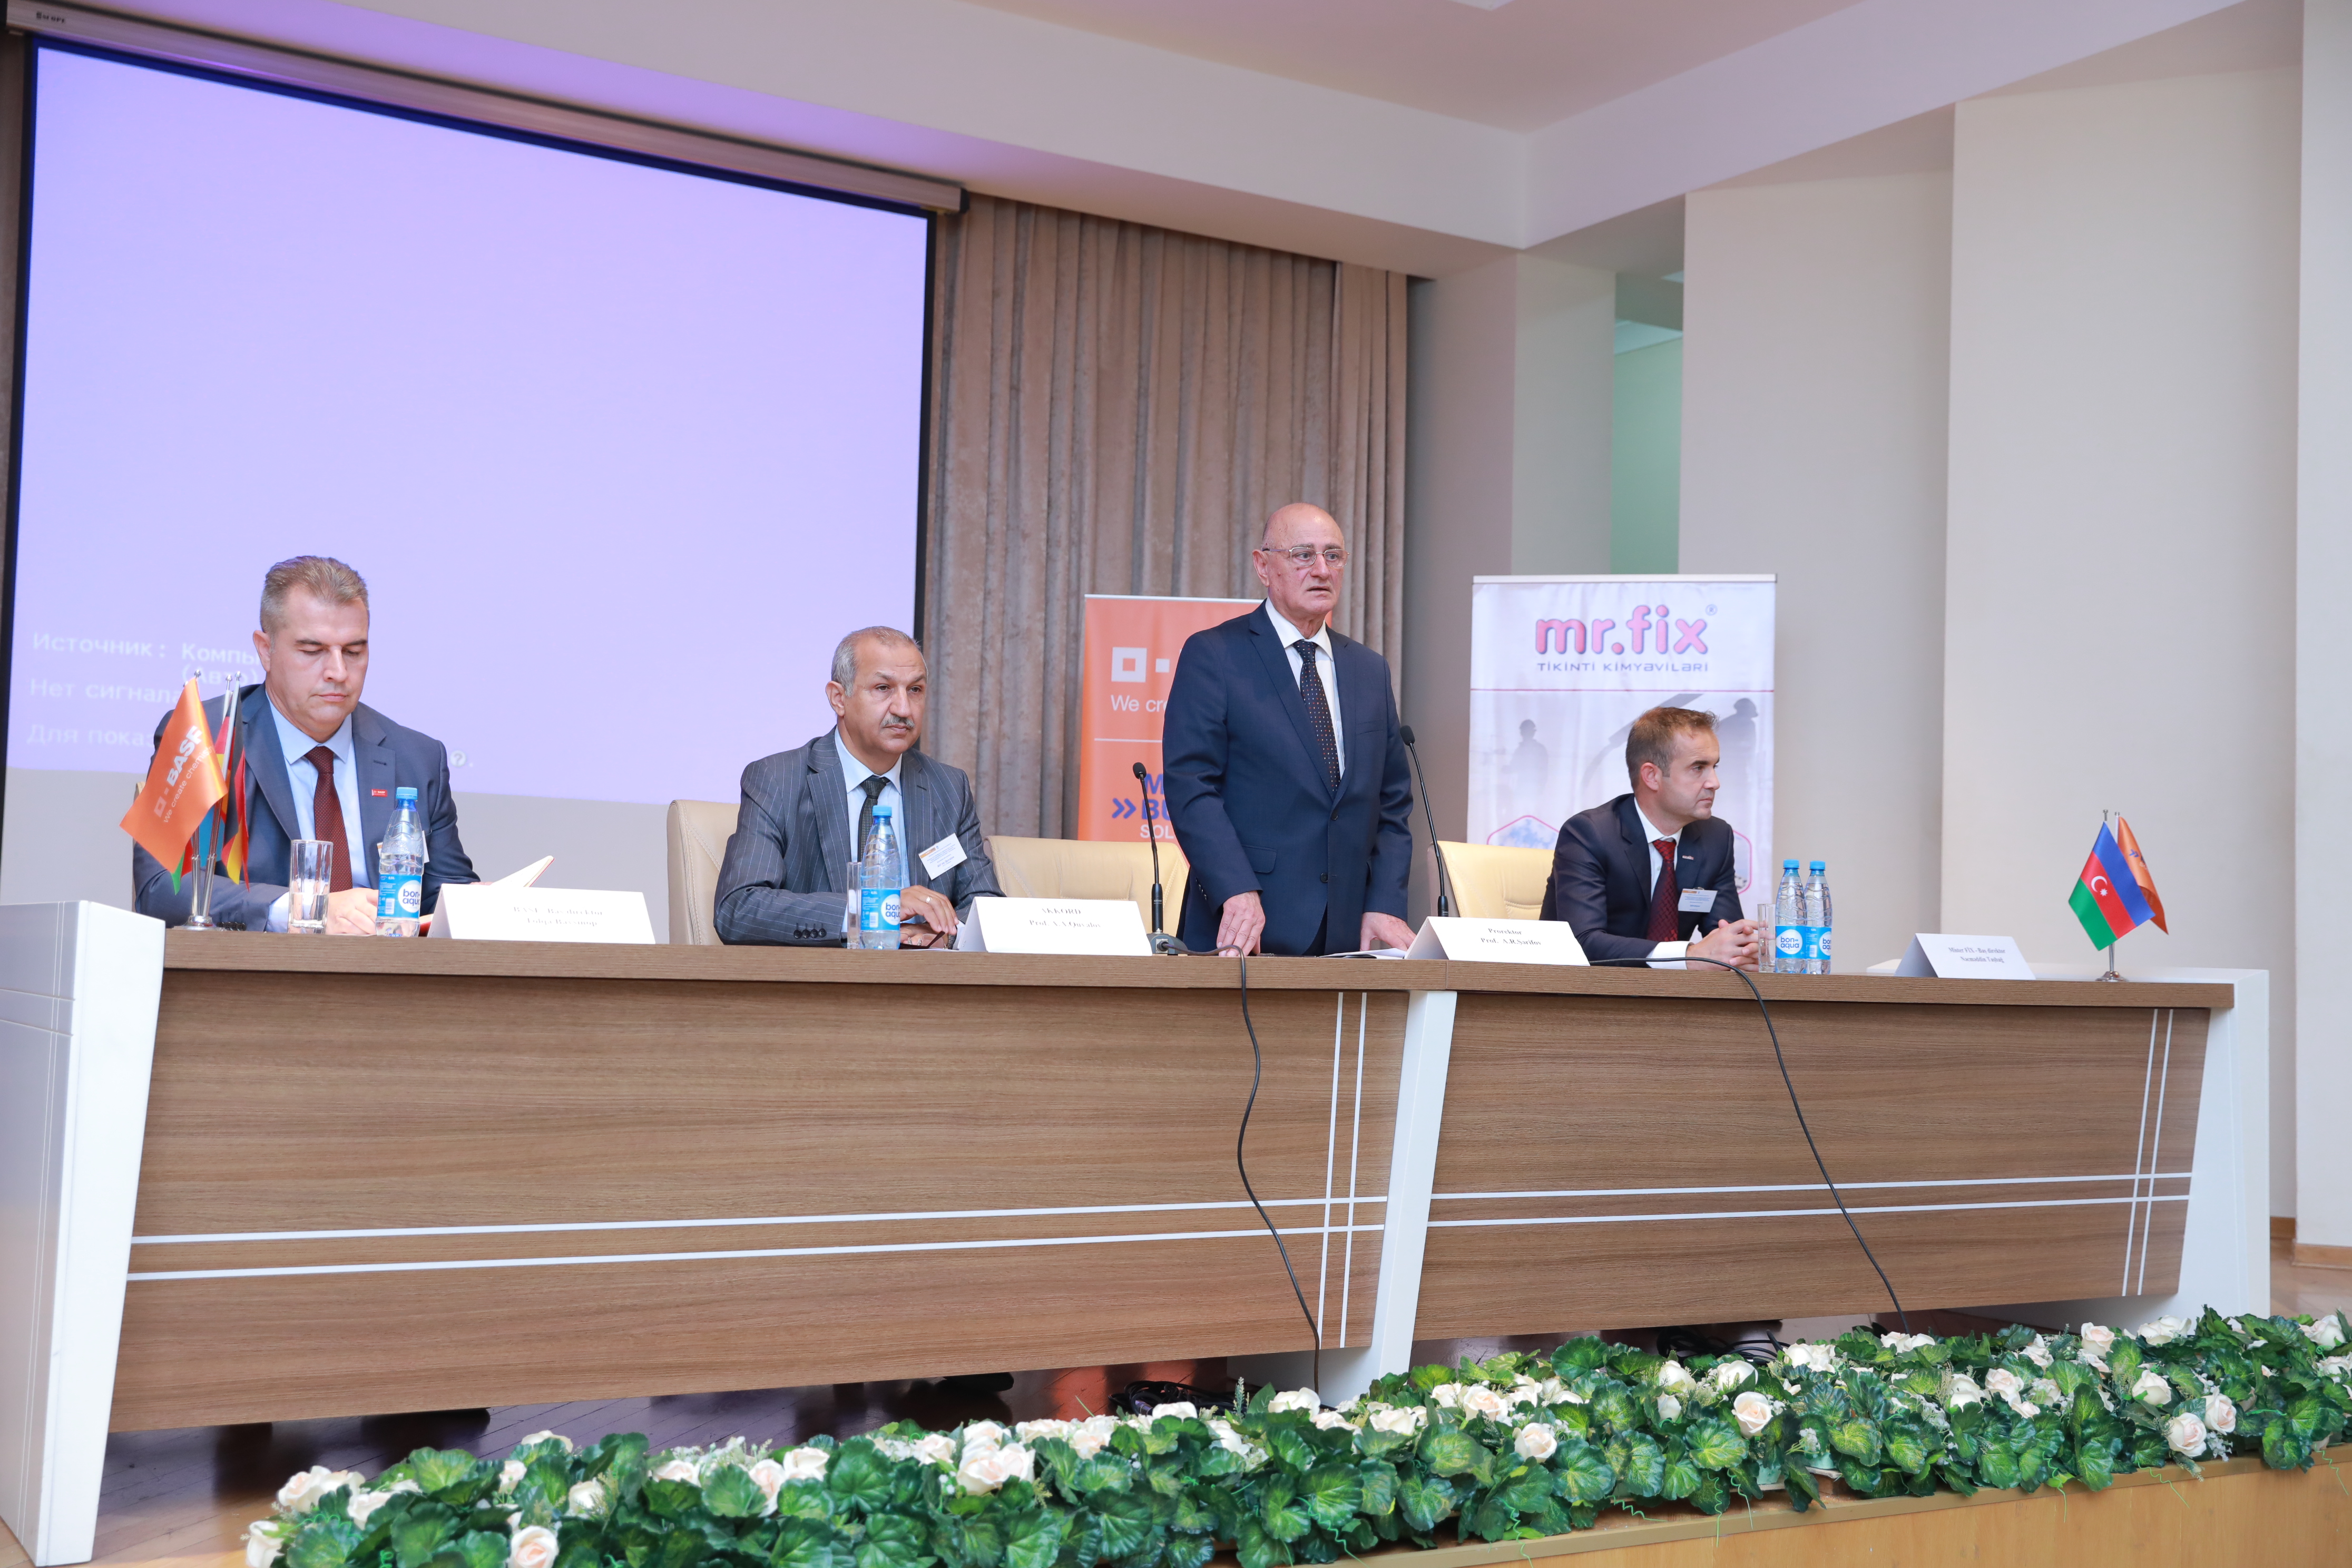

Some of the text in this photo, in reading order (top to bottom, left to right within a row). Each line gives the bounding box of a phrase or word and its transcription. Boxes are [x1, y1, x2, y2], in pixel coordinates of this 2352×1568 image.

[1535, 605, 1709, 655] mr.fix
[30, 678, 76, 697] Нет
[1110, 694, 1140, 712] We
[26, 724, 77, 746] Для
[166, 726, 202, 787] BASF
[163, 809, 172, 823] We
[171, 780, 187, 807] create
